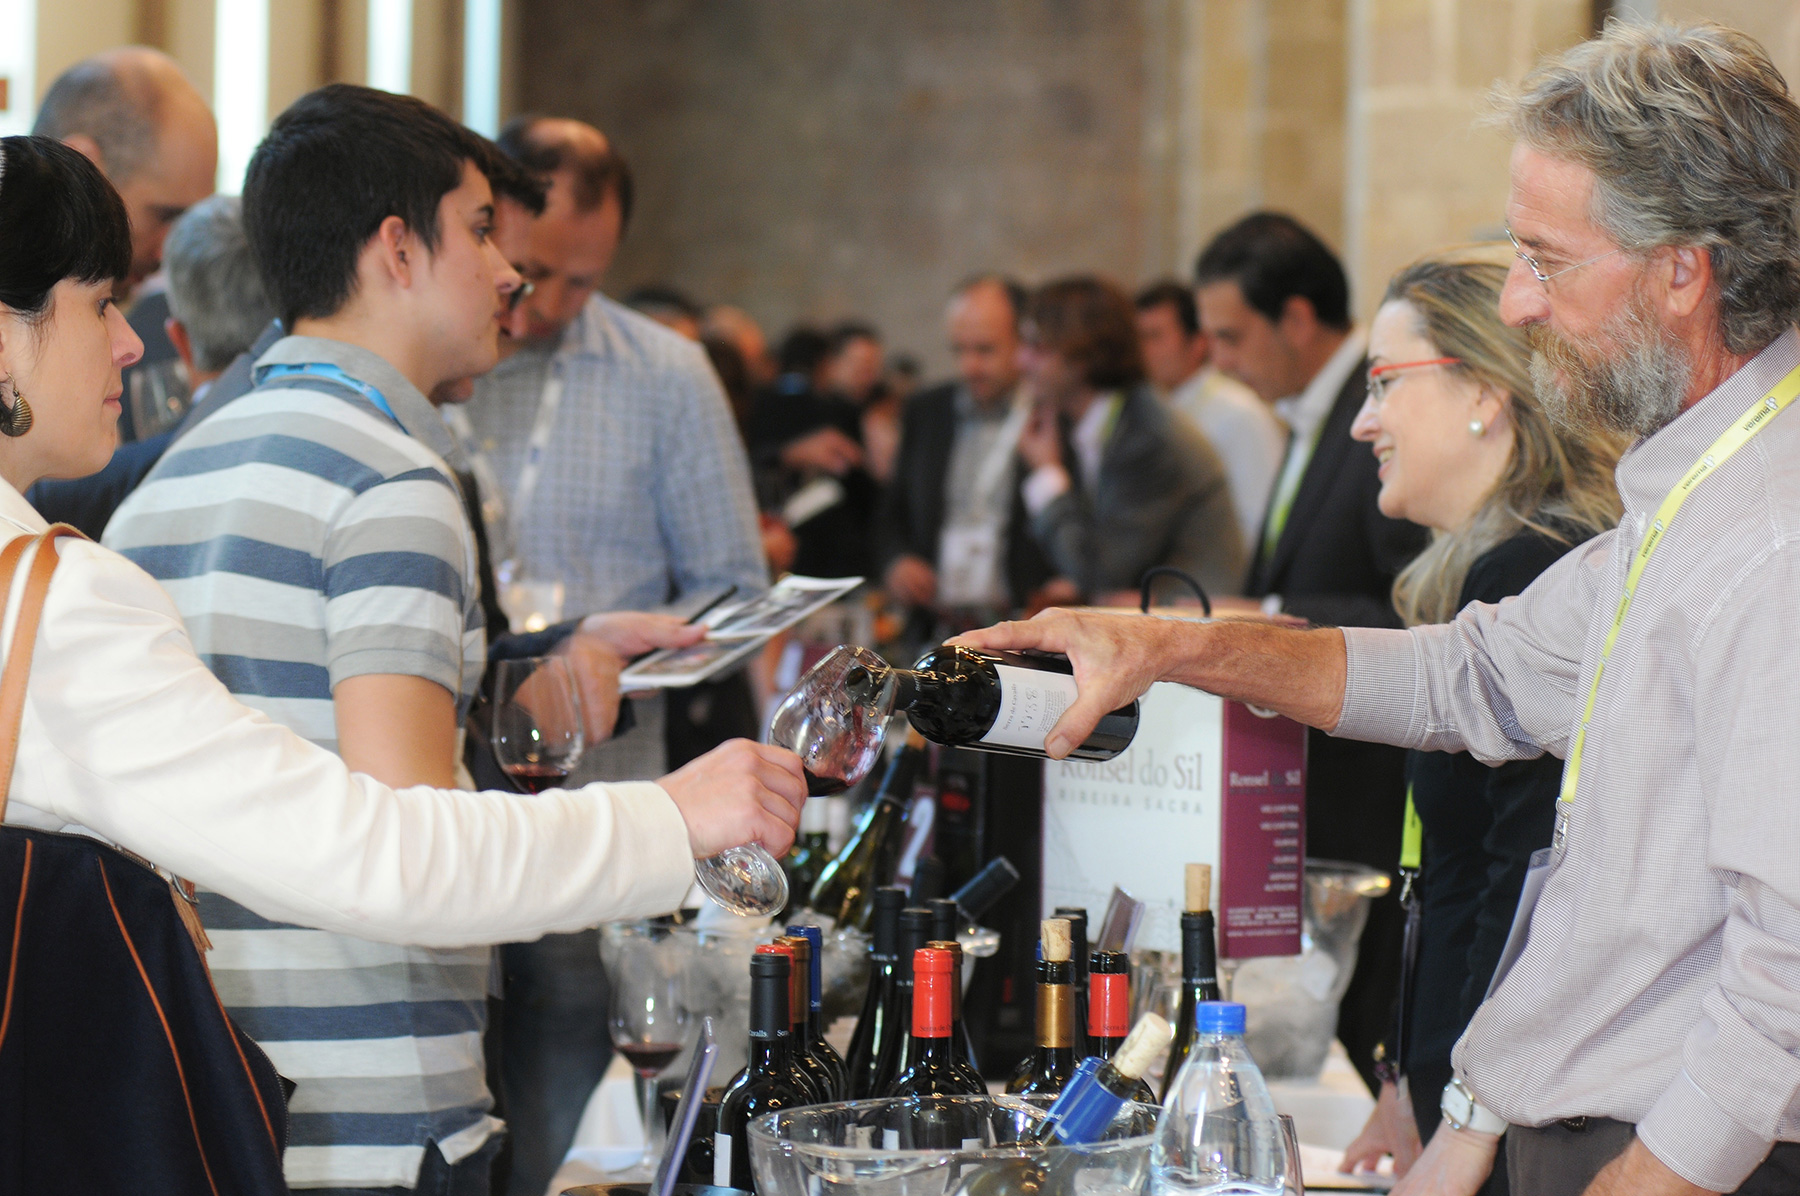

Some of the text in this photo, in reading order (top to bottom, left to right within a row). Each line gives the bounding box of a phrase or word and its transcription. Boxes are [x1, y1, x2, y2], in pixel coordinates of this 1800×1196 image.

[1743, 406, 1771, 432] verema
[1140, 748, 1168, 787] do
[1173, 753, 1203, 792] Sil
